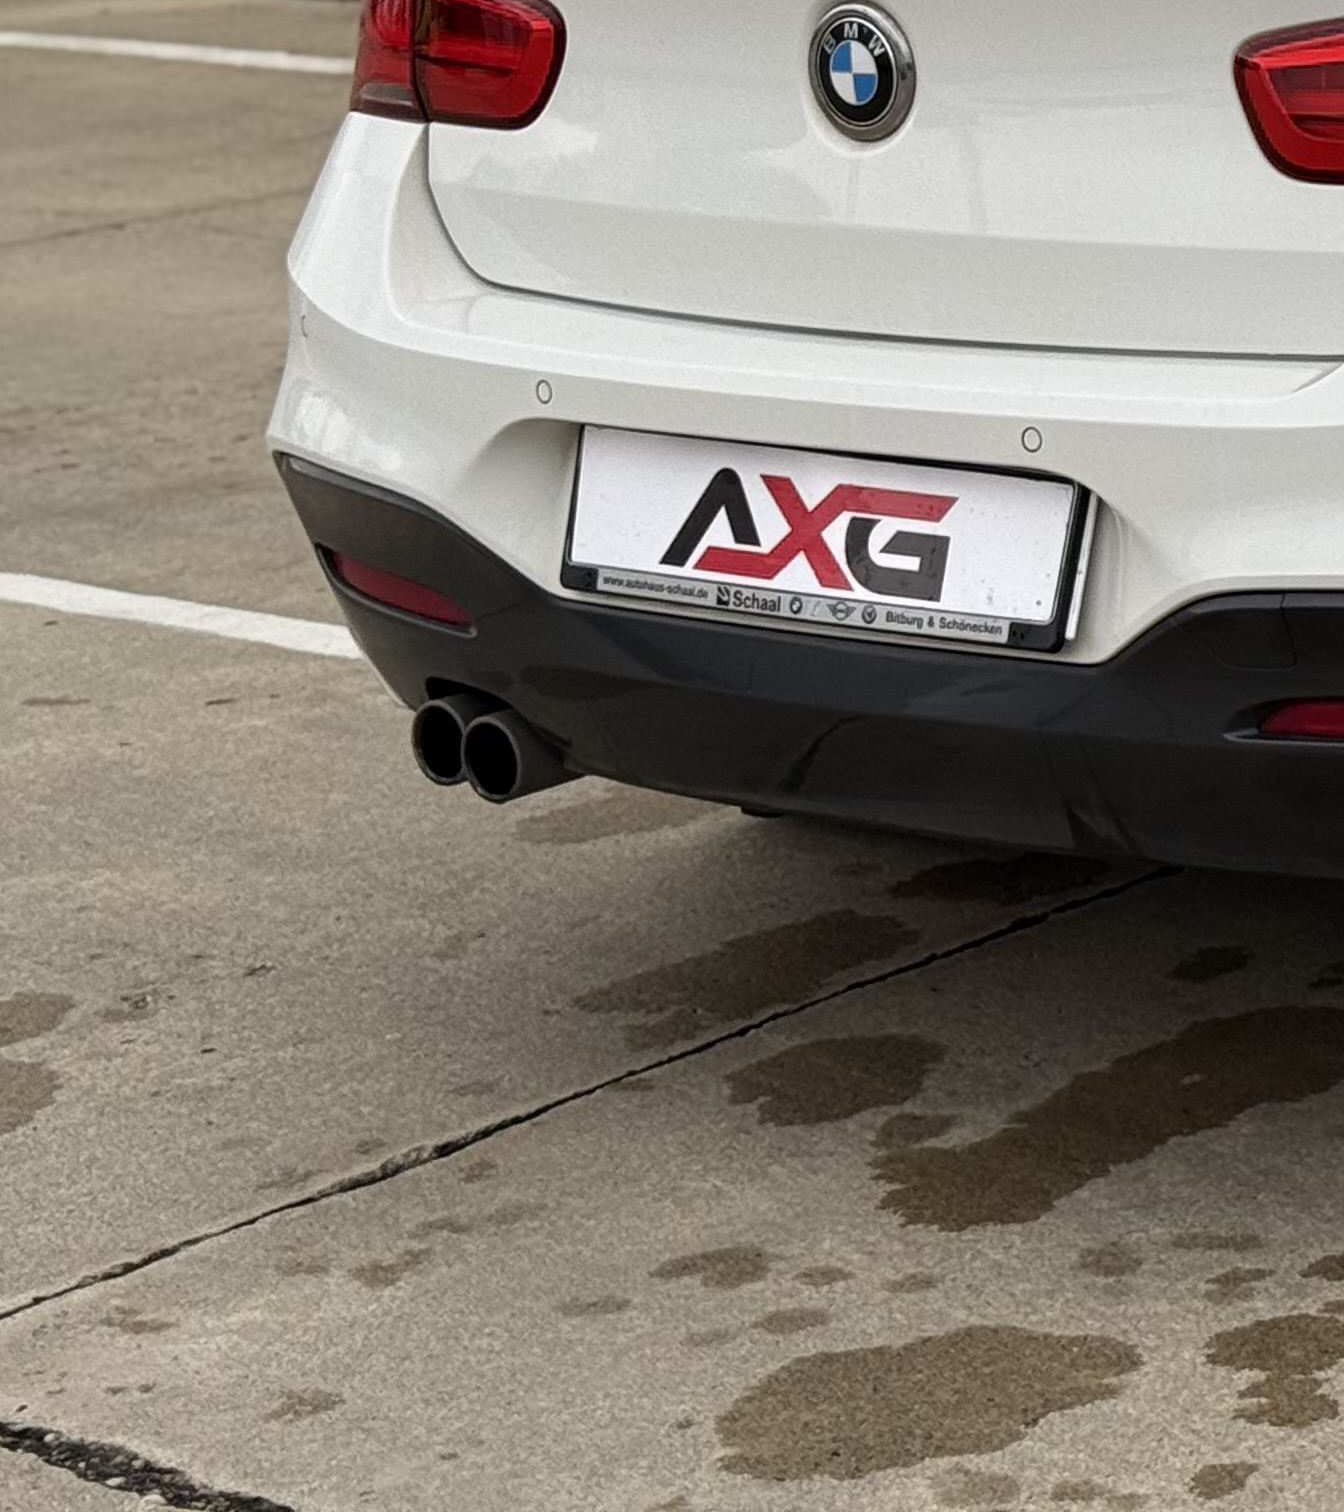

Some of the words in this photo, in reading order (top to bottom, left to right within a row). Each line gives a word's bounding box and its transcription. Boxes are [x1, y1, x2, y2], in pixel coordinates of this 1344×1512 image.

[823, 22, 885, 58] BMW
[659, 467, 959, 602] AXG
[603, 576, 709, 599] www.autohaus-schaal.de
[732, 589, 782, 613] Schaal
[886, 610, 924, 630] Bitburg
[927, 617, 935, 628] &
[939, 616, 1003, 635] Schönecken
